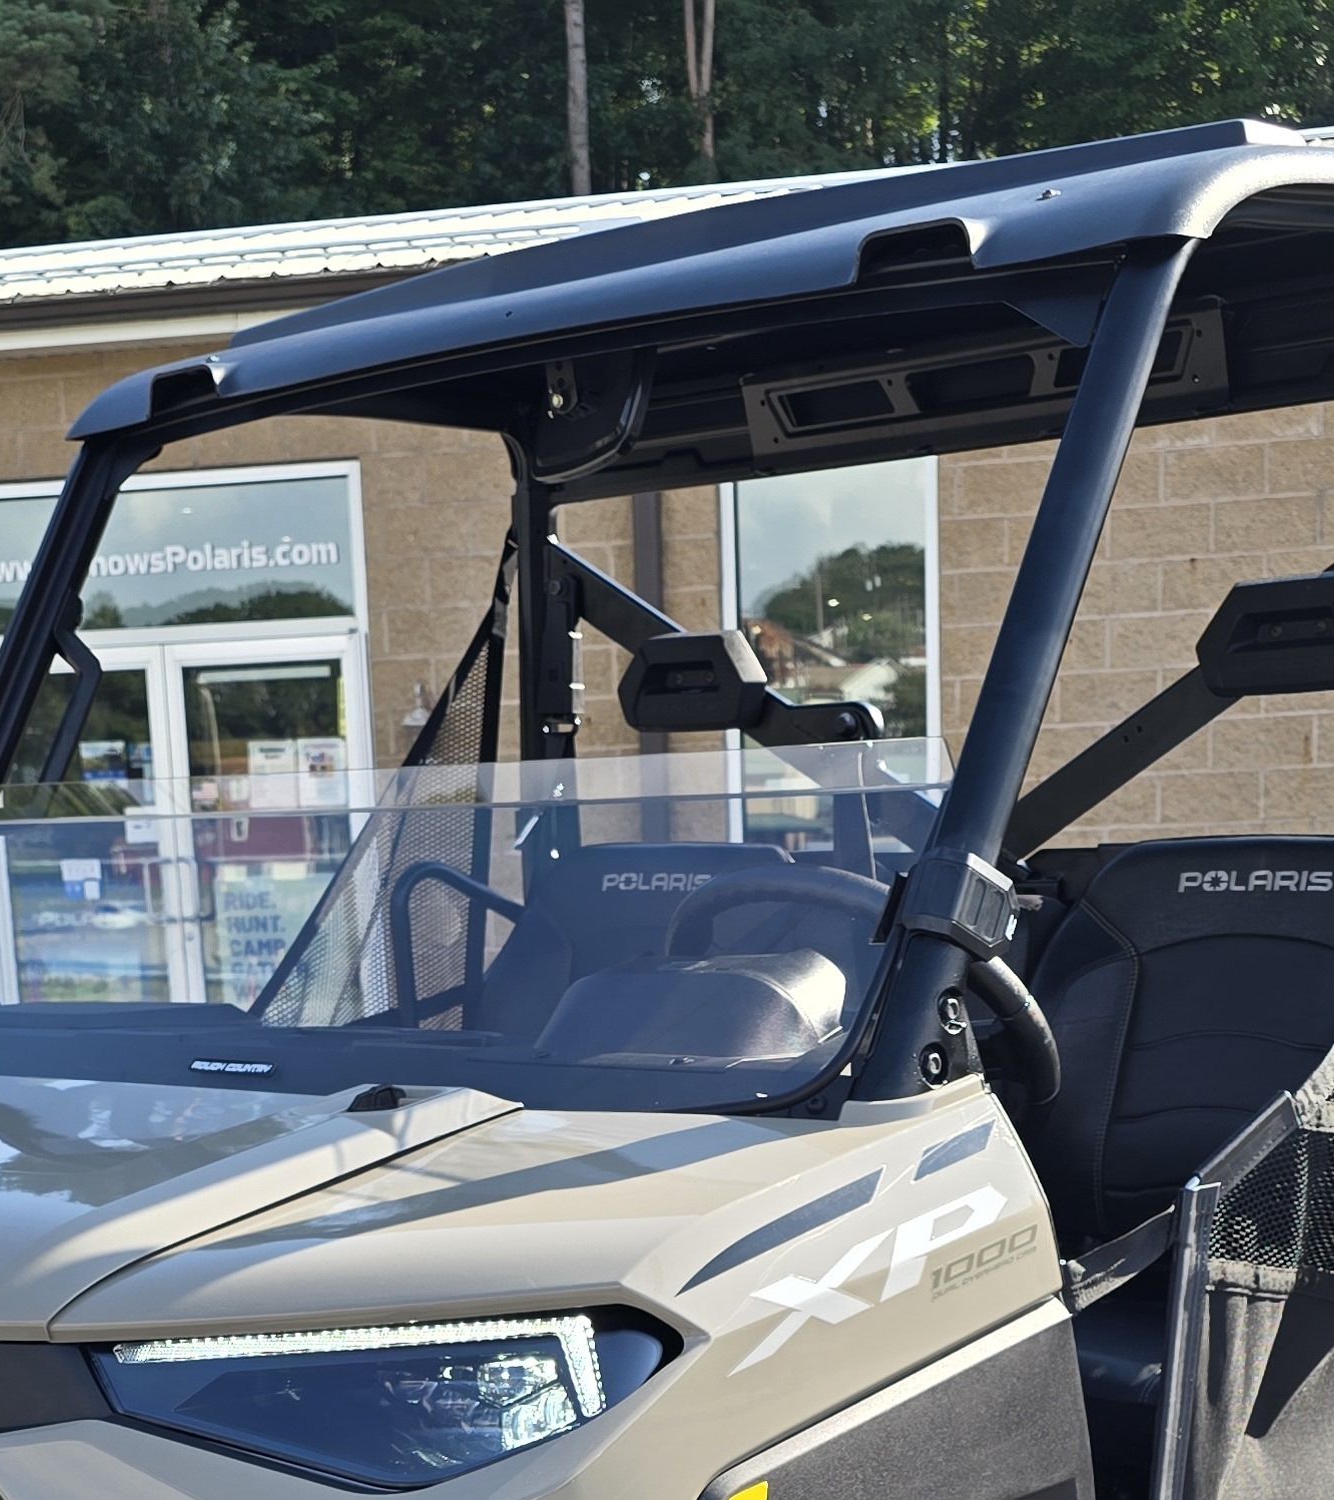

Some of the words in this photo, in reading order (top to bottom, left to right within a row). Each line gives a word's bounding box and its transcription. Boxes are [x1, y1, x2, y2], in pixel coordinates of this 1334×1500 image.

[1178, 869, 1334, 893] POLARIS
[725, 1183, 1008, 1379] XP
[931, 1223, 1038, 1291] 1000
